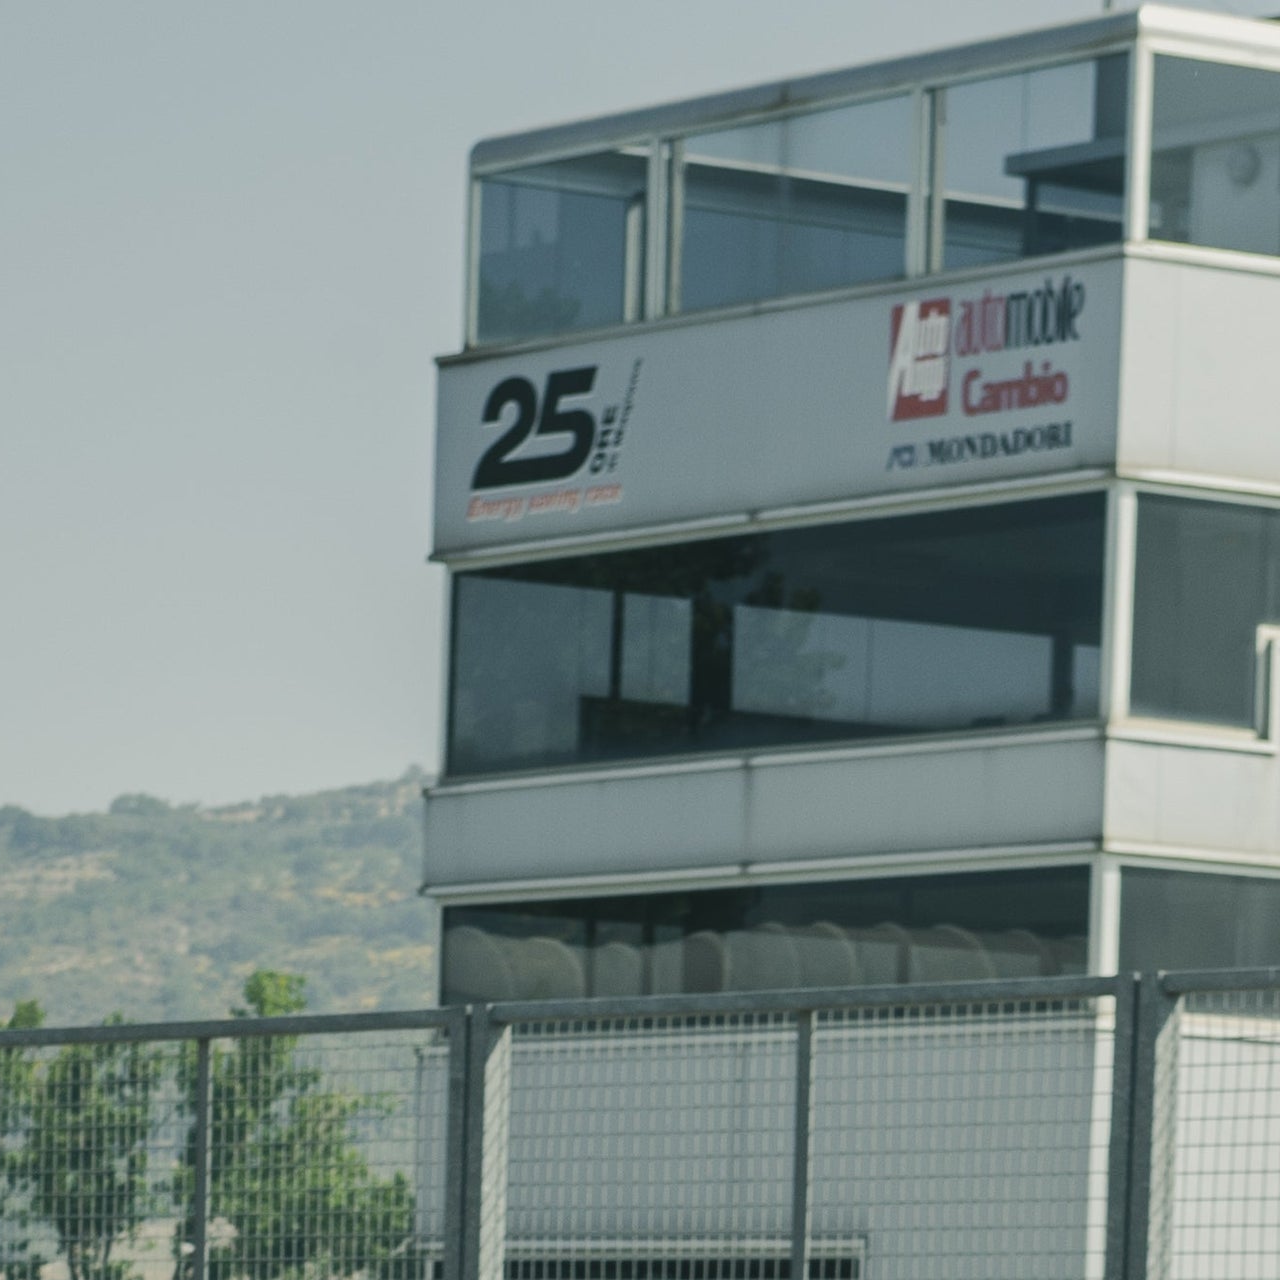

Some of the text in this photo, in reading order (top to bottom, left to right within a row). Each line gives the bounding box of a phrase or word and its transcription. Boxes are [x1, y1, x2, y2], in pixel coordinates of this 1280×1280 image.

[961, 361, 1068, 416] Cambio
[472, 366, 599, 490] 25
[927, 422, 1072, 466] MONDADORI
